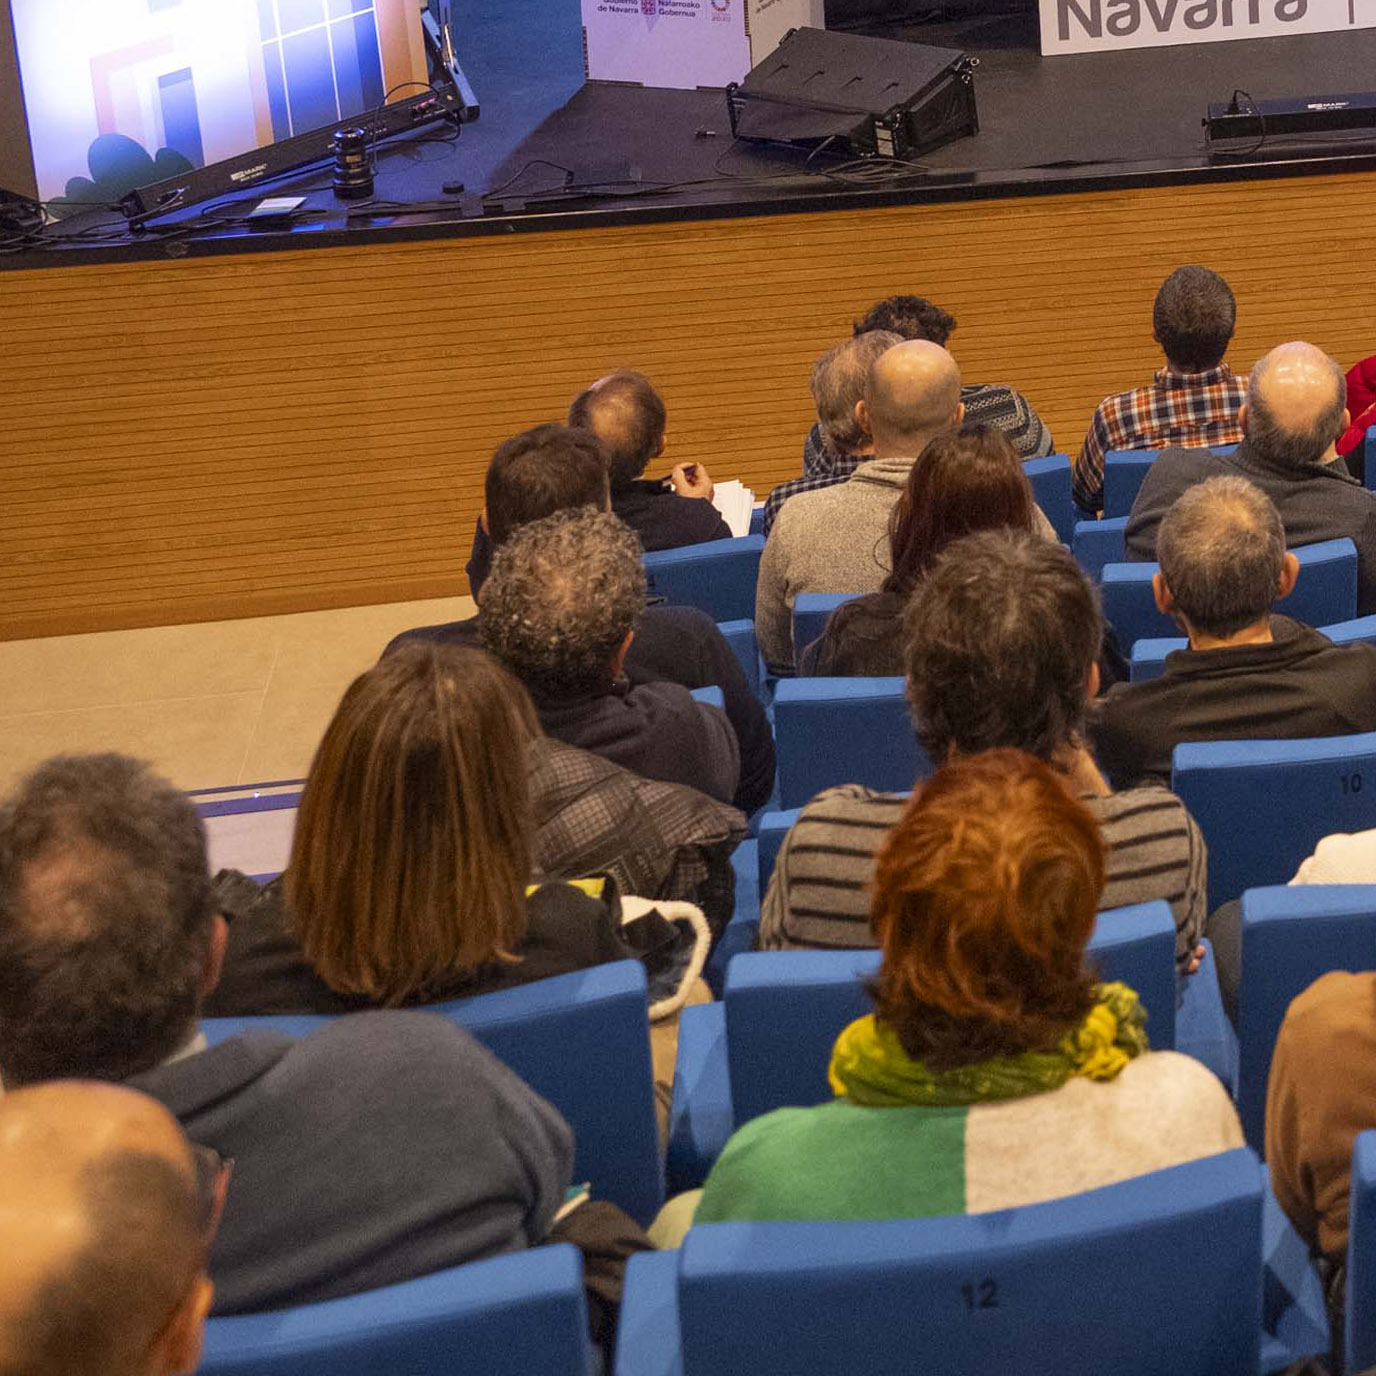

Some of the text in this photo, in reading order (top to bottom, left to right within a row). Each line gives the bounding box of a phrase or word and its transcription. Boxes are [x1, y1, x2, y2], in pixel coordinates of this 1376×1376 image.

[597, 4, 639, 14] de Navarra
[658, 8, 696, 18] Gobernua
[1340, 773, 1362, 795] 10
[961, 1278, 999, 1311] 12
